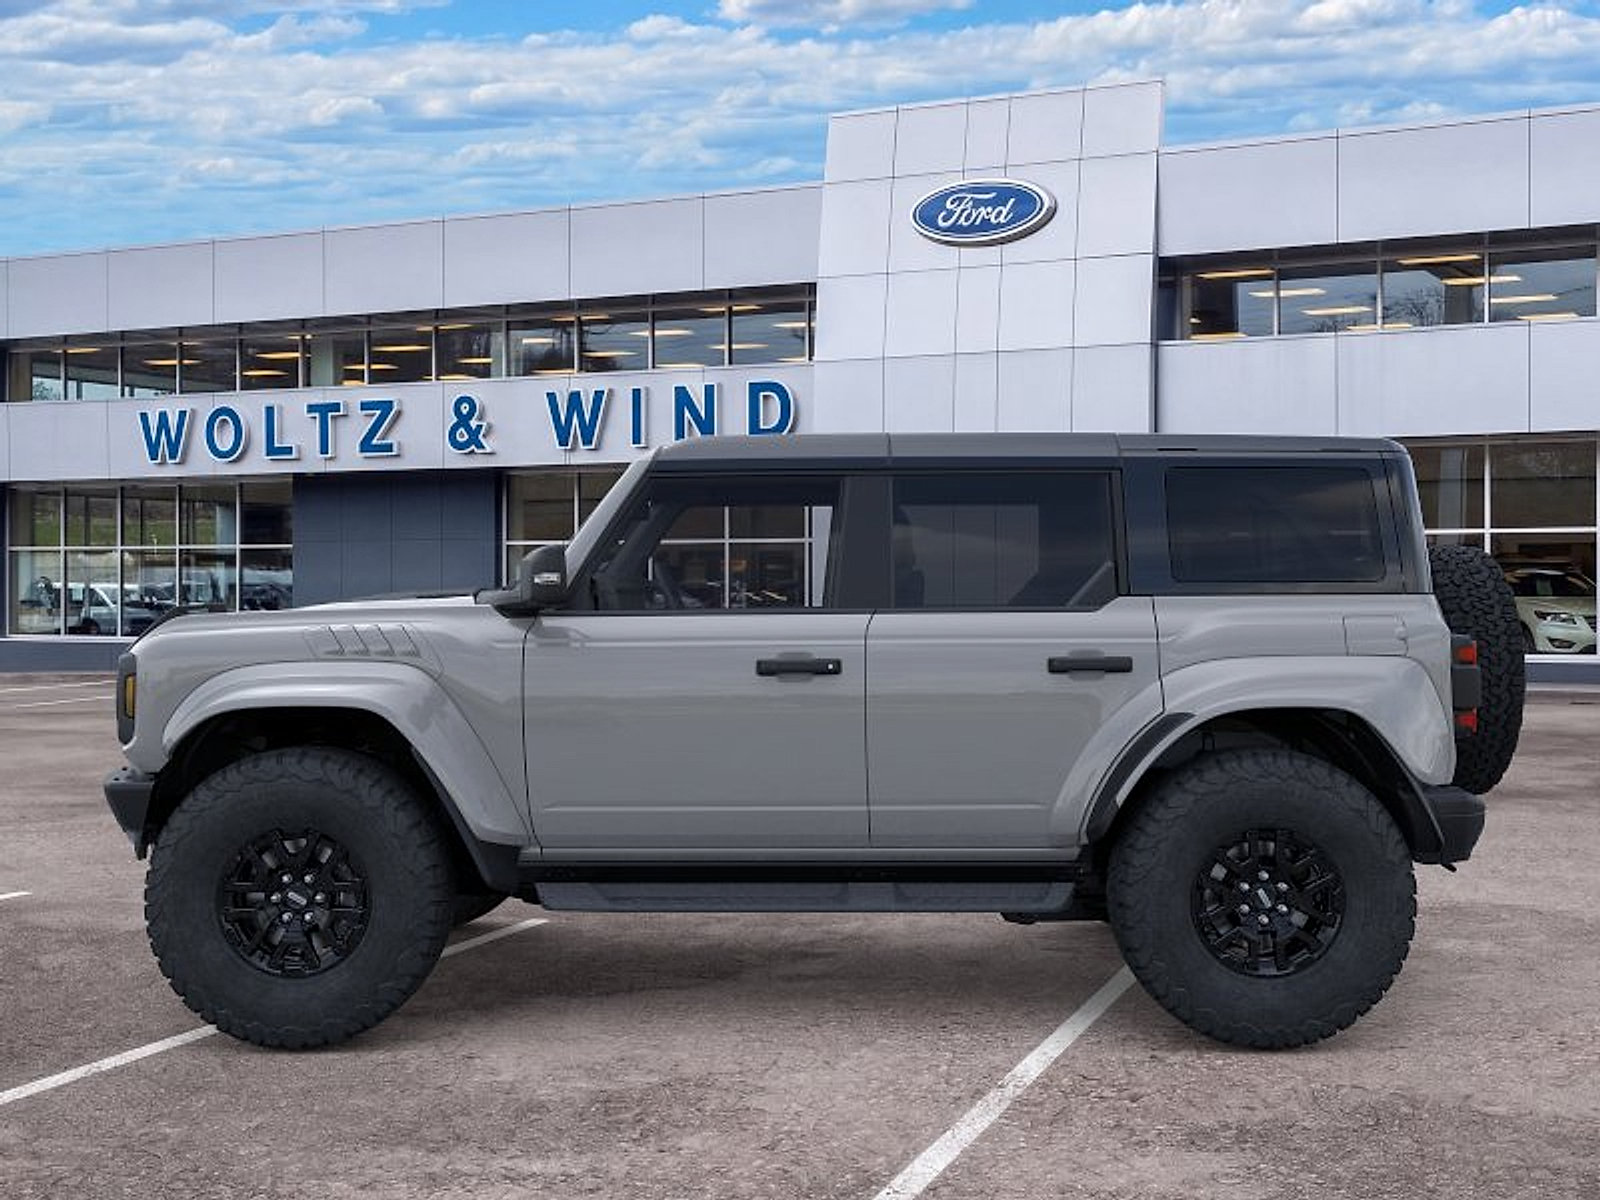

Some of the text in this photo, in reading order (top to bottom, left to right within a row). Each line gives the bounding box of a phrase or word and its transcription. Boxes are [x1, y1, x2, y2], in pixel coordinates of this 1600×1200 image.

[937, 192, 1015, 227] Ford
[138, 379, 795, 464] WOLTZ & WIND
